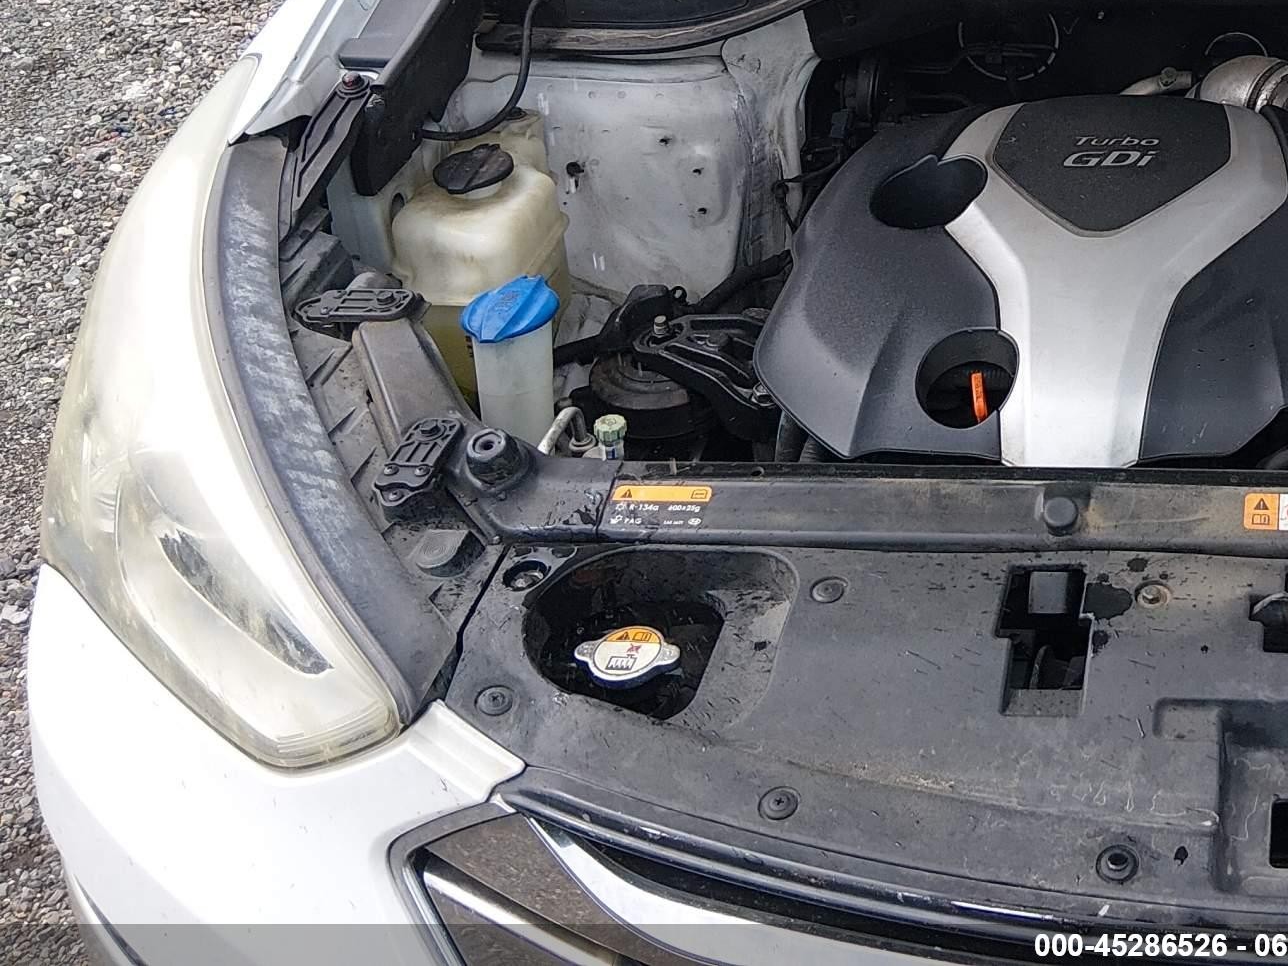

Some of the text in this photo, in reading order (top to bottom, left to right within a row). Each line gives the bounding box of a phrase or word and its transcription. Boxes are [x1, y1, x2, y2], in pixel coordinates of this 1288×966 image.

[1075, 136, 1160, 146] Turbo
[1064, 150, 1160, 167] GDi
[629, 503, 660, 511] R-134a
